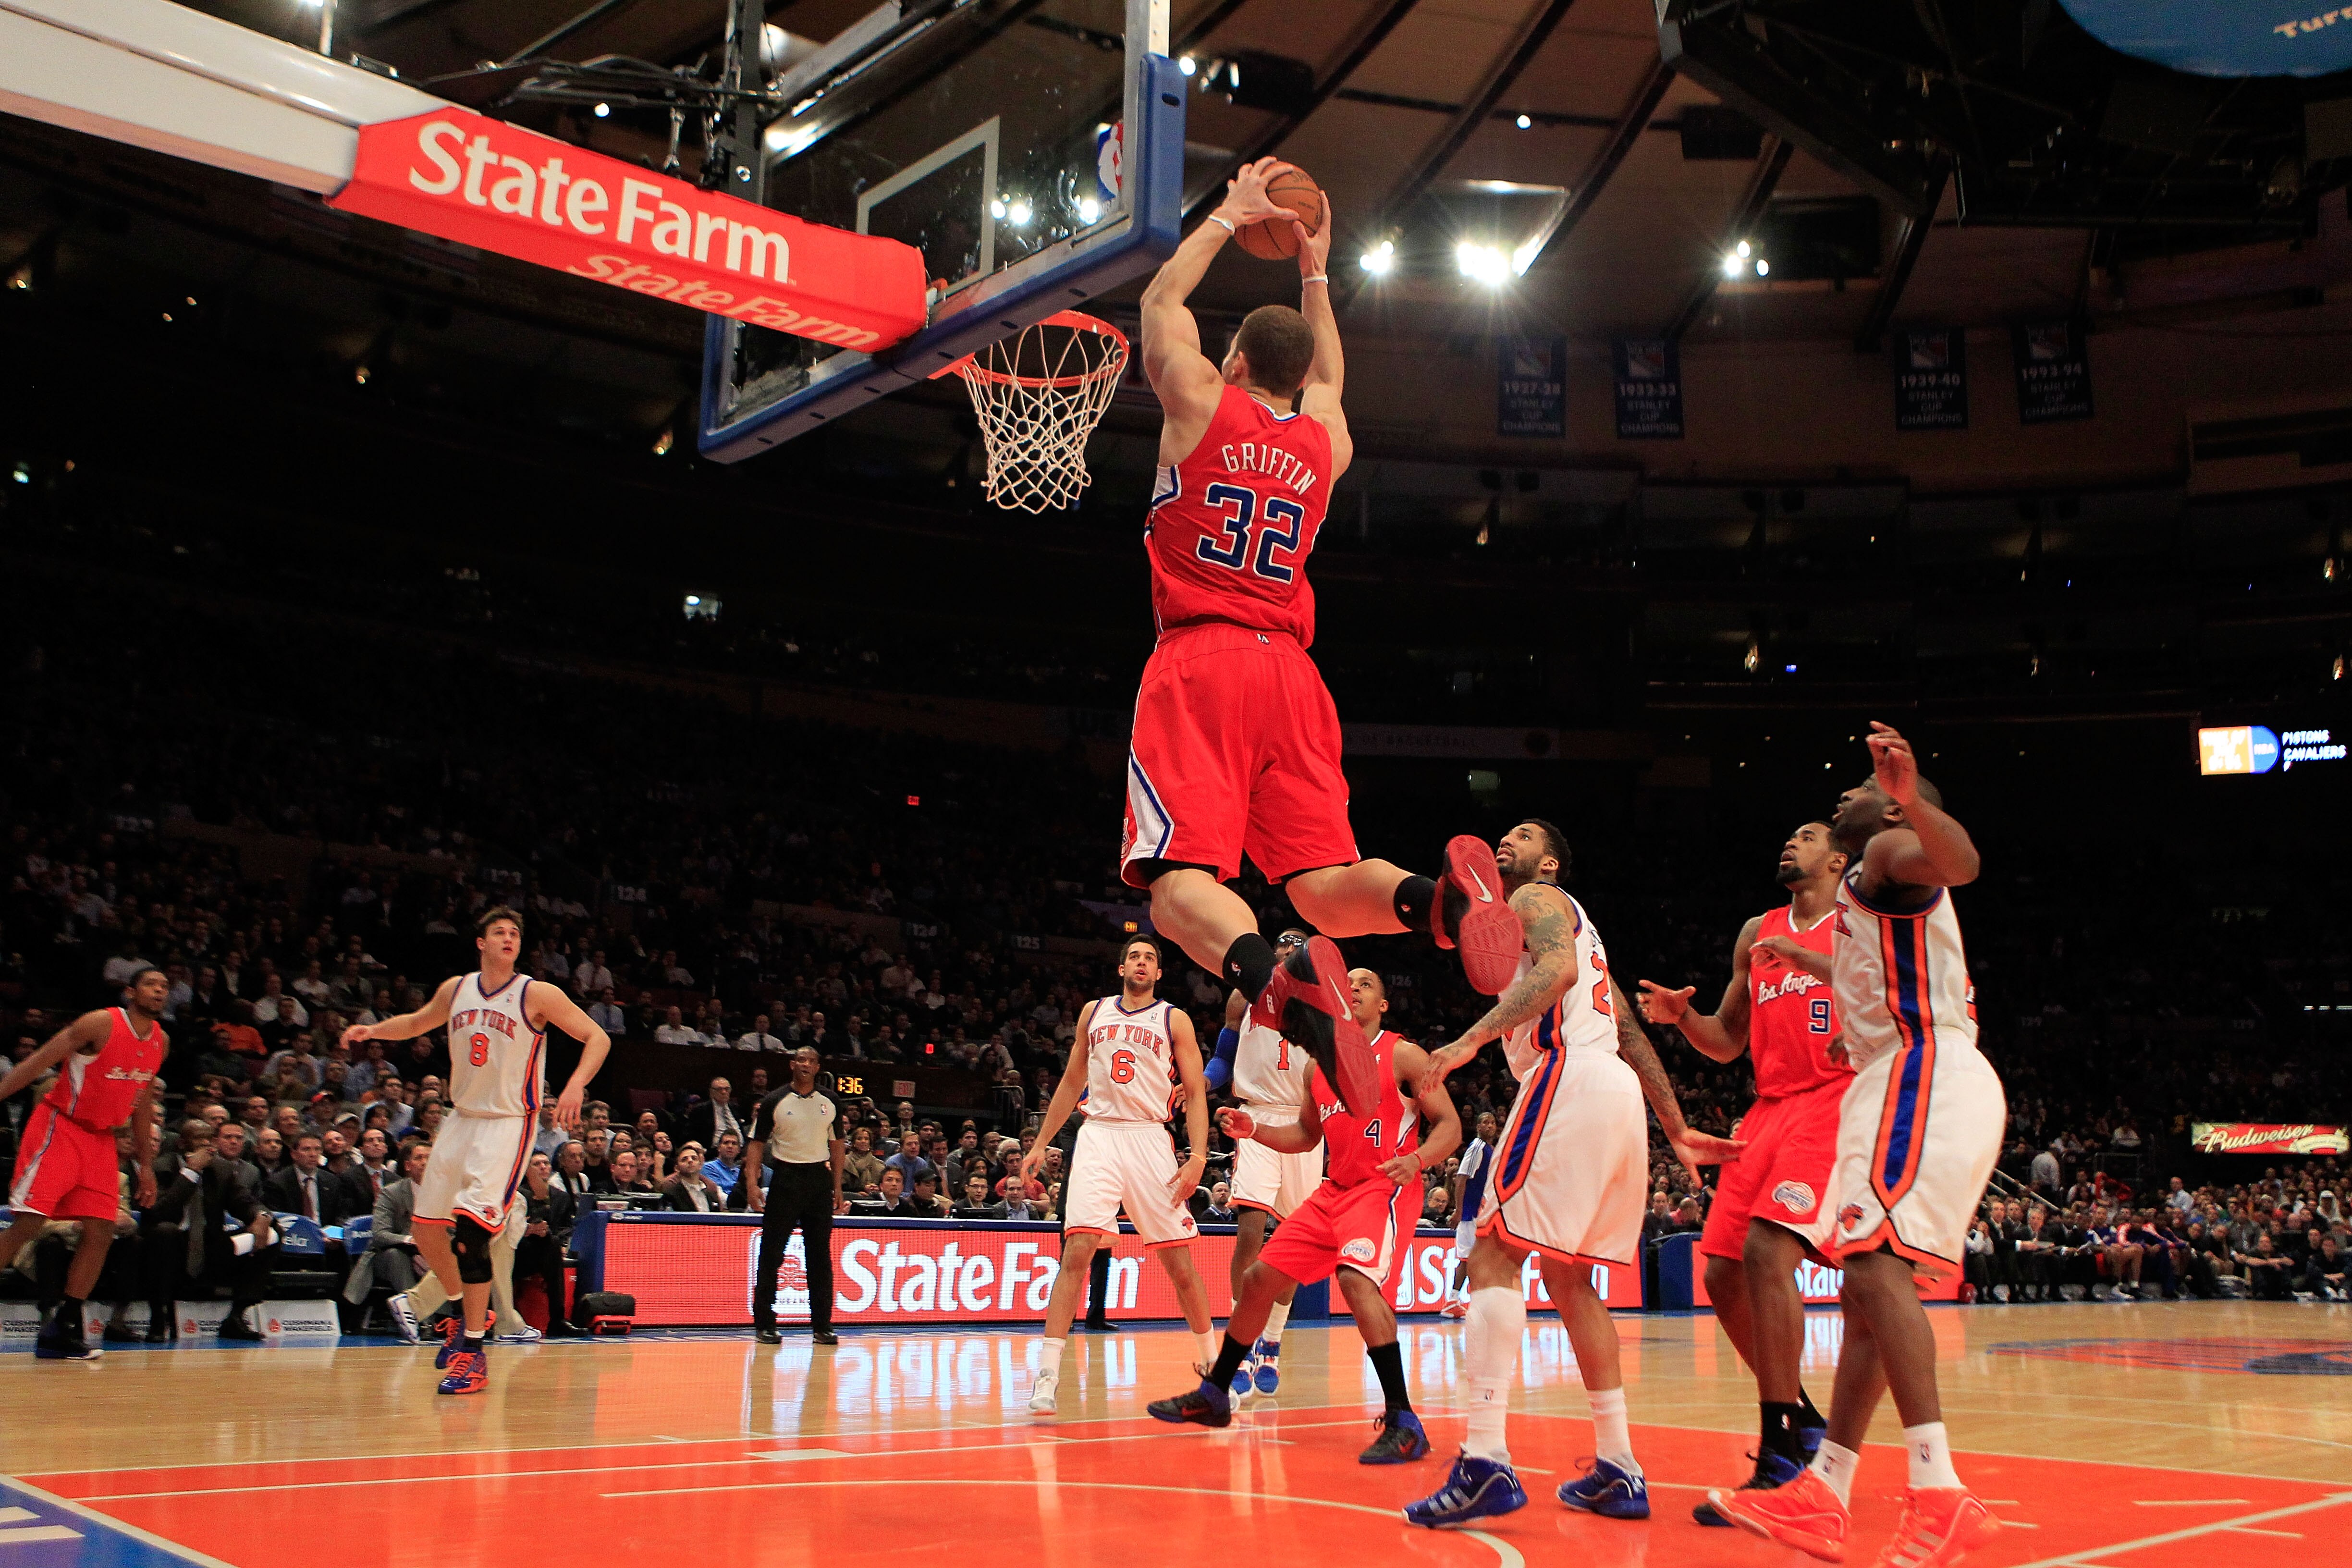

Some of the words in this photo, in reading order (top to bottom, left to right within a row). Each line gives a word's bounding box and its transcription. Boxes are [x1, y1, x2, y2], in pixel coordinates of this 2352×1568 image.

[409, 120, 609, 235] State
[616, 177, 791, 284] Farm
[566, 253, 735, 307] State
[728, 294, 881, 348] Farm
[1221, 442, 1317, 496] GRIFFIN
[1196, 481, 1305, 586] 32
[2282, 729, 2330, 746] PISTONS
[2283, 744, 2348, 761] CAVALIERS
[1015, 934, 1040, 950] 125
[1757, 980, 1778, 1005] Los
[453, 1009, 479, 1032] NEW
[482, 1008, 517, 1041] YORK
[1808, 998, 1832, 1035] 9
[469, 1032, 490, 1067] 8
[1090, 1024, 1121, 1052] NEW
[1125, 1024, 1164, 1060] YORK
[1277, 1037, 1290, 1071] 1
[1111, 1049, 1136, 1084] 6
[1363, 1117, 1382, 1148] 4
[2193, 1123, 2315, 1154] Budweiser
[834, 1237, 995, 1313] State
[998, 1241, 1140, 1312] Fam
